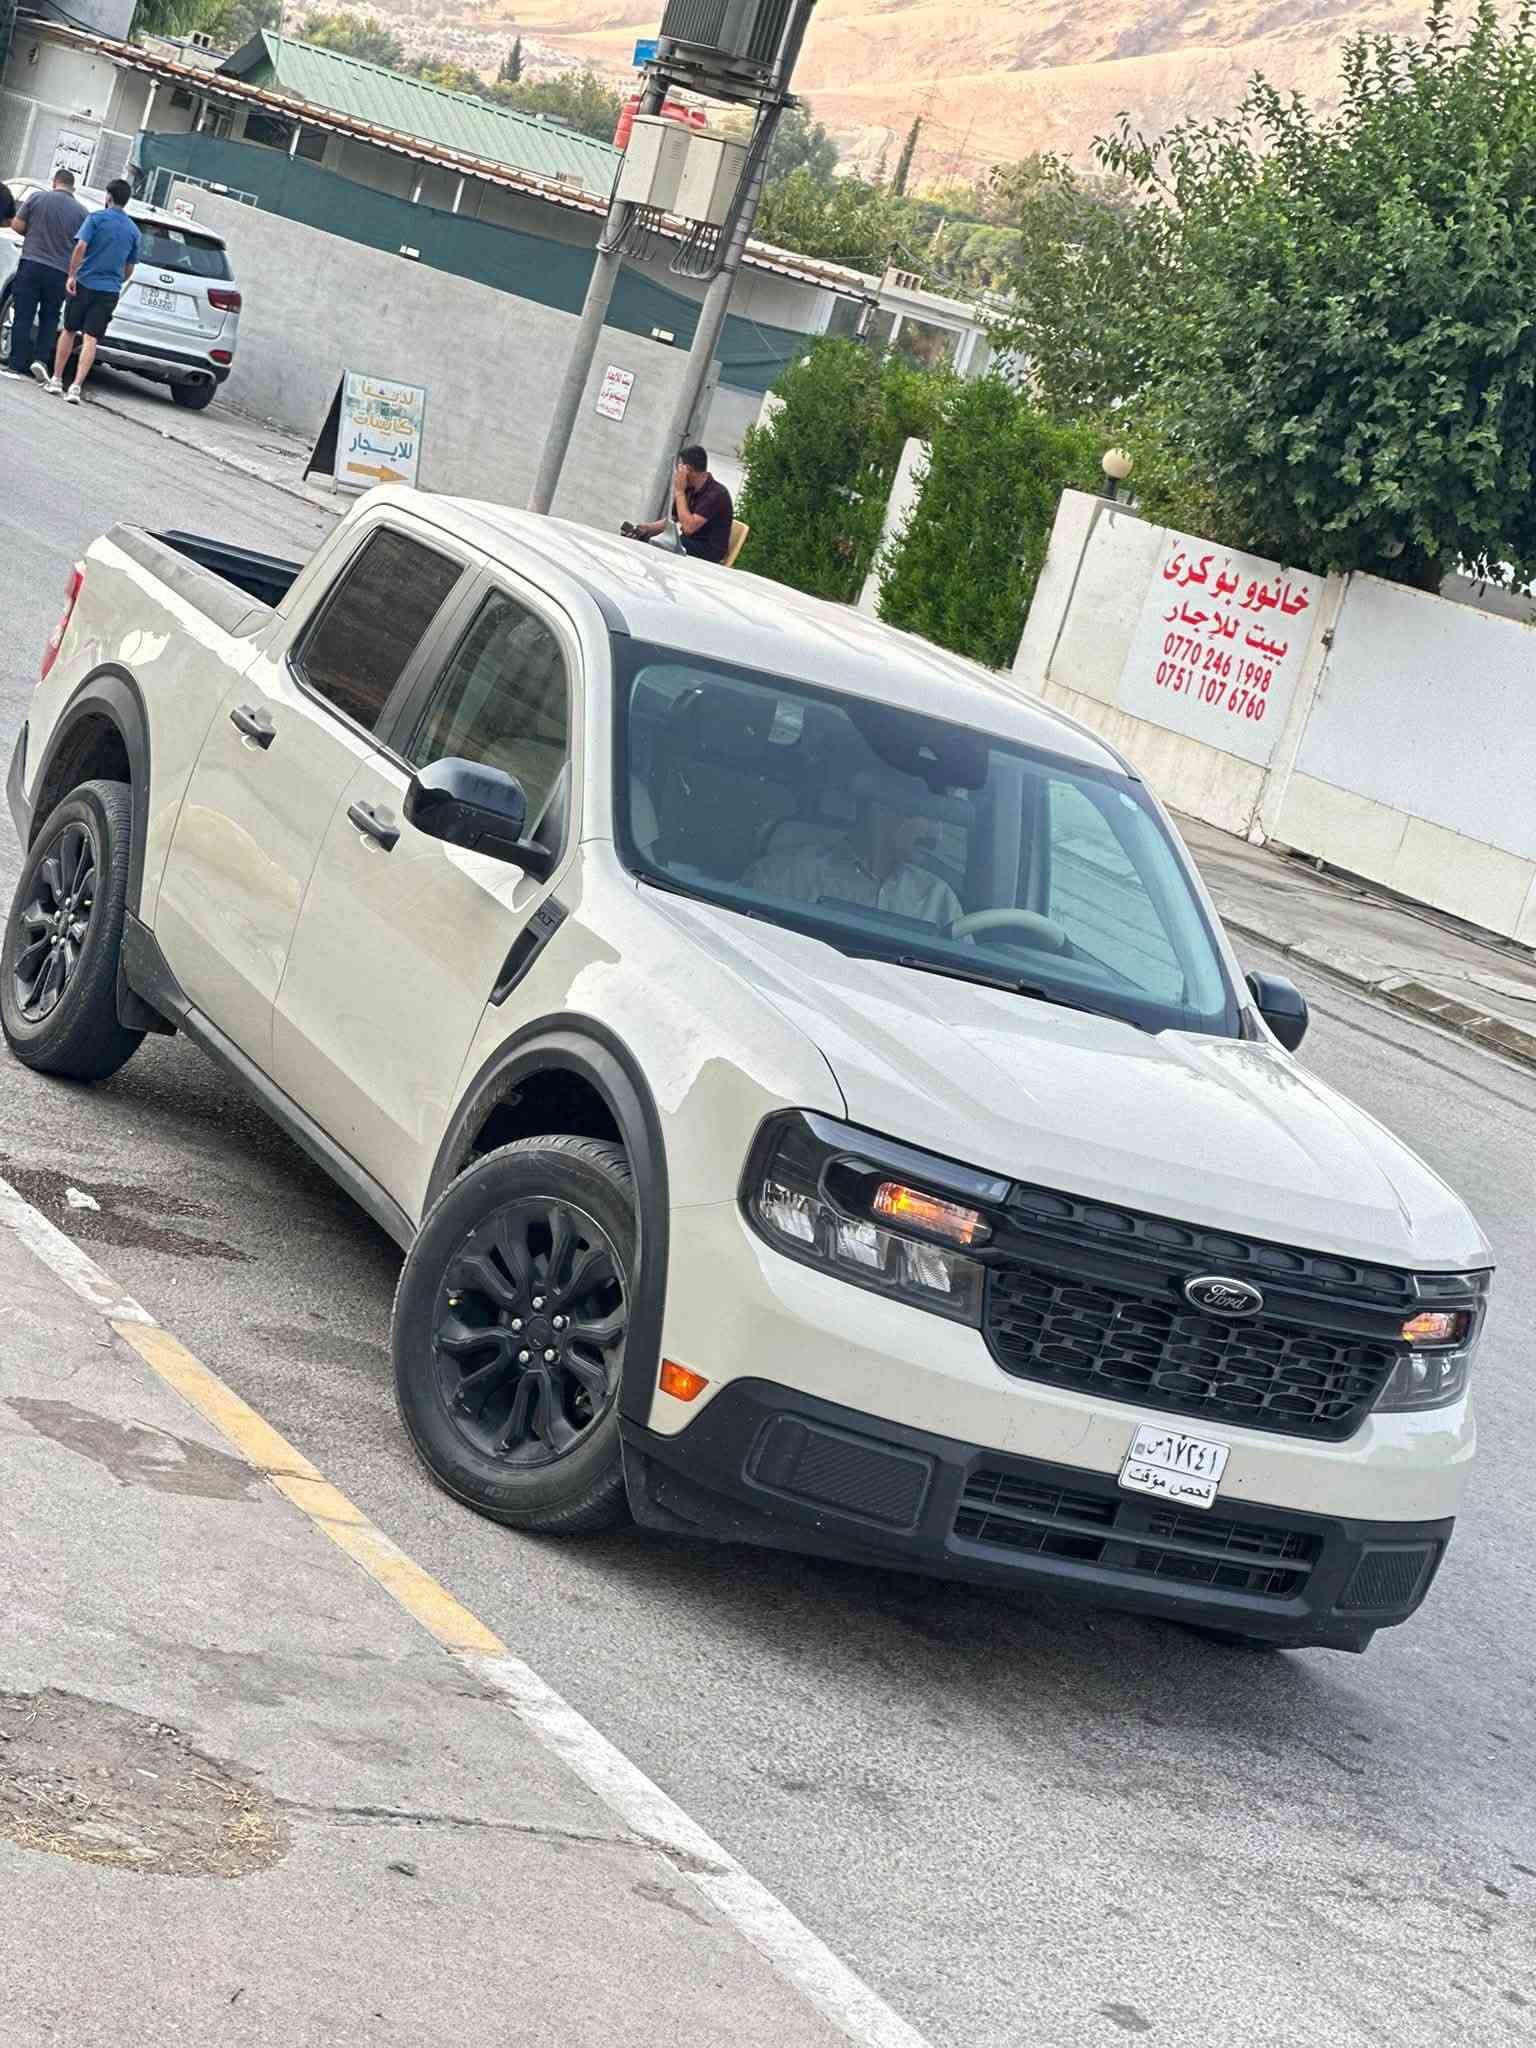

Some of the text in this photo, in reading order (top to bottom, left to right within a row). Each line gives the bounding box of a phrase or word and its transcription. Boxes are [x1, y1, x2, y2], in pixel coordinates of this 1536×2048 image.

[349, 432, 413, 462] للايجار
[1163, 632, 1272, 693] 0770 246 1998
[1155, 661, 1266, 721] 0751 107 6760
[1204, 1284, 1248, 1310] Ford
[1169, 1484, 1212, 1499] فحص
